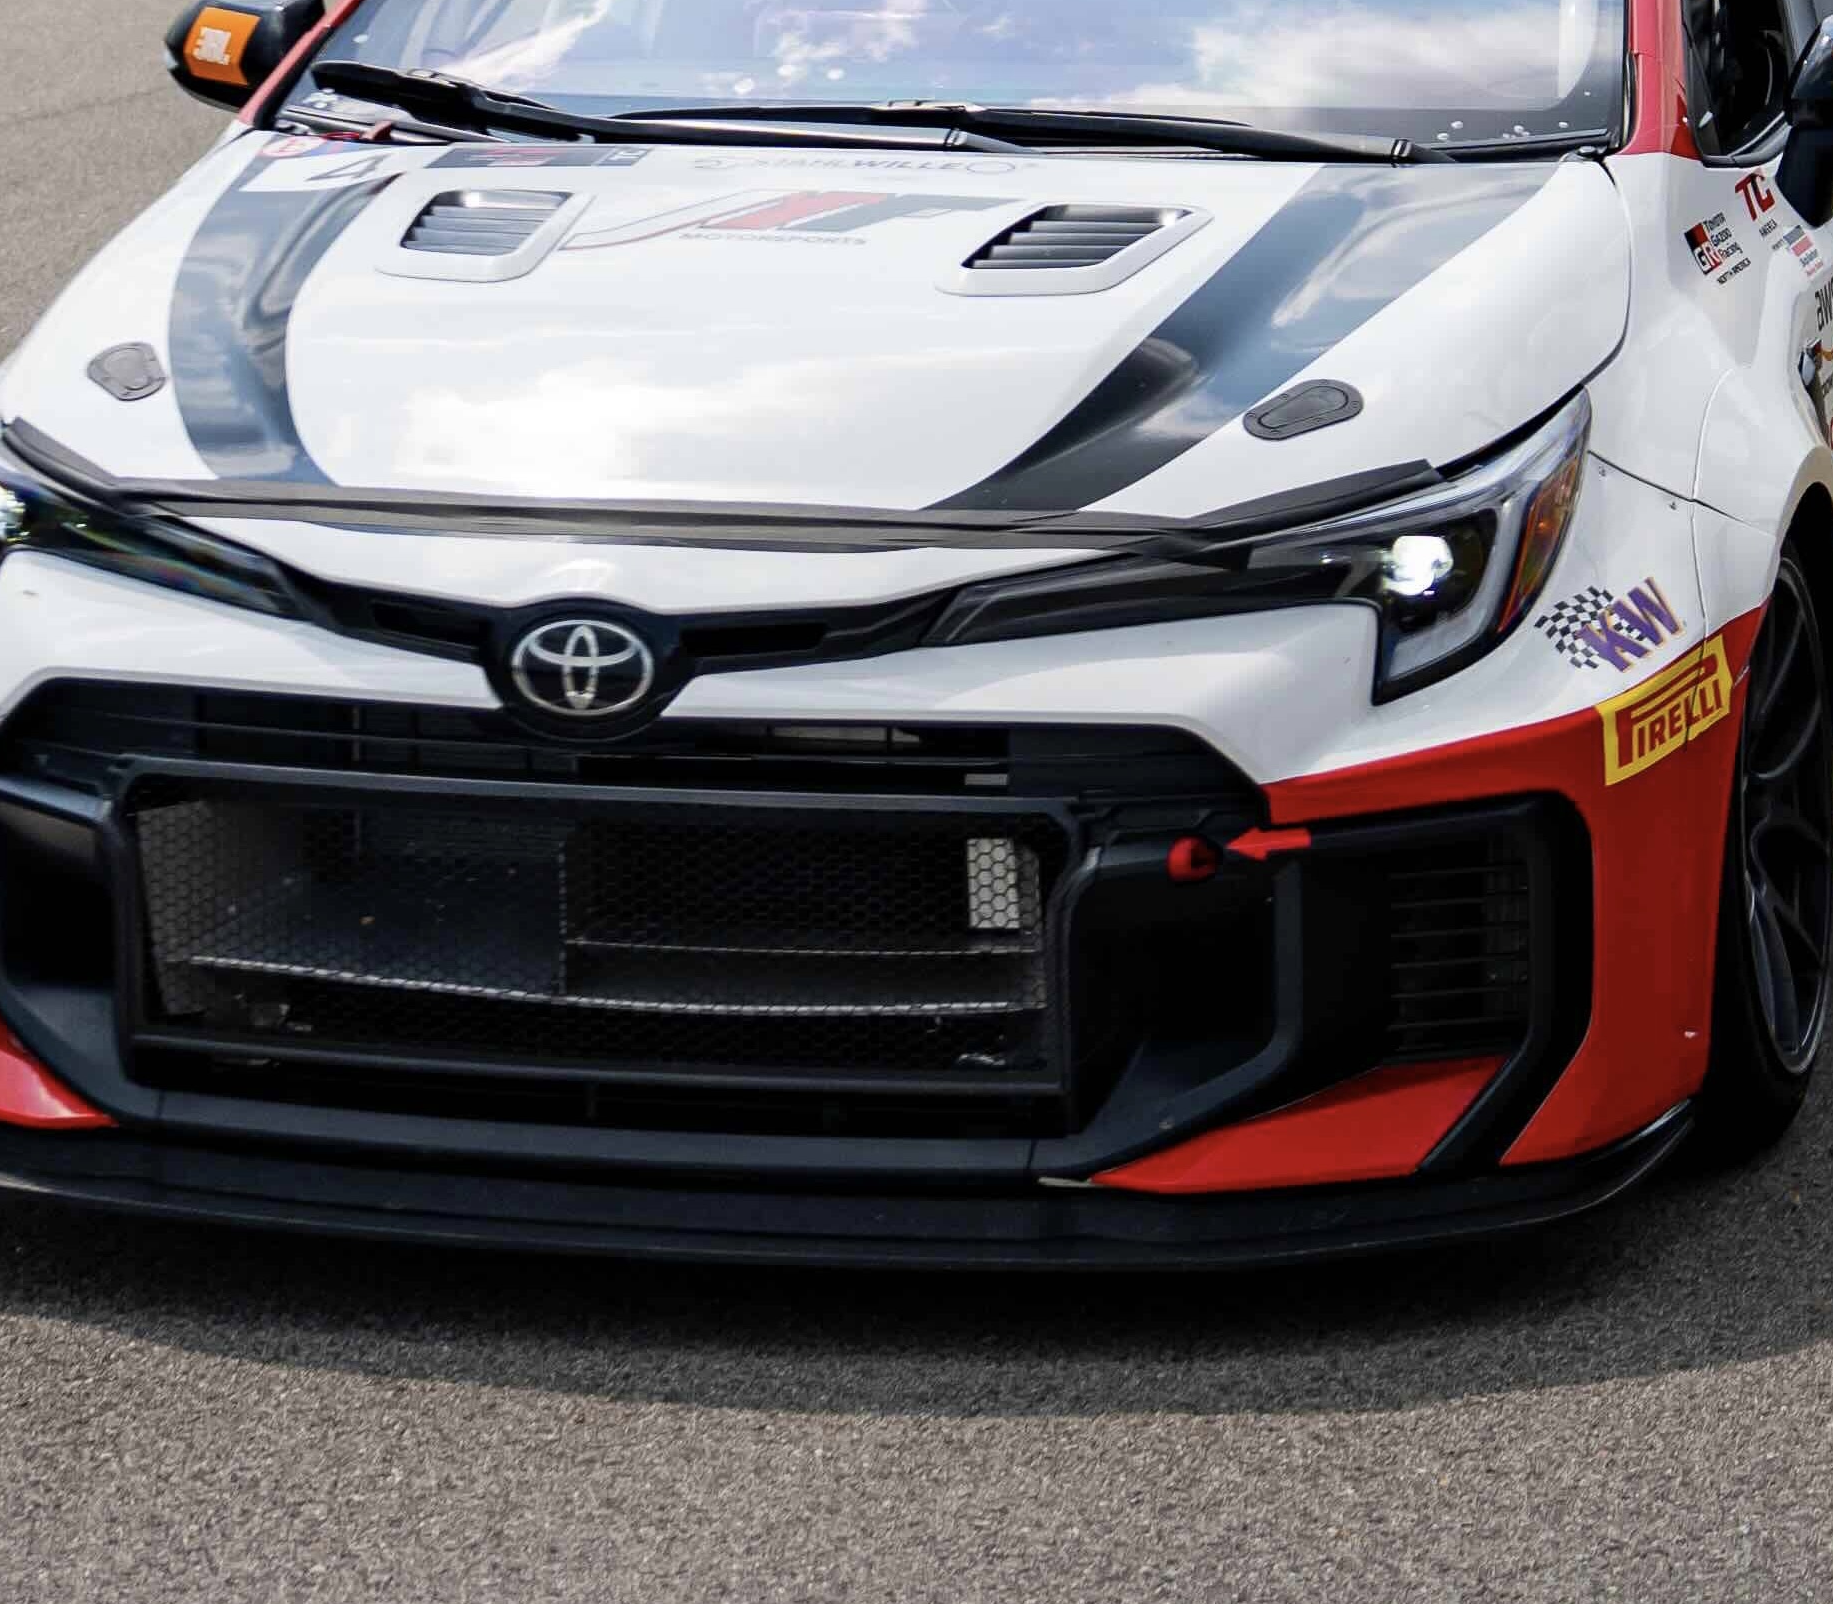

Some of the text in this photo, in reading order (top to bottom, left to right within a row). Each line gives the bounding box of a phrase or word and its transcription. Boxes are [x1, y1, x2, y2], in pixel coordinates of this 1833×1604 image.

[1735, 168, 1775, 221] TC
[678, 232, 866, 245] MOTORSPORTS
[1694, 241, 1723, 272] GR
[1575, 576, 1681, 673] KW
[1614, 653, 1724, 769] PIRELLI
